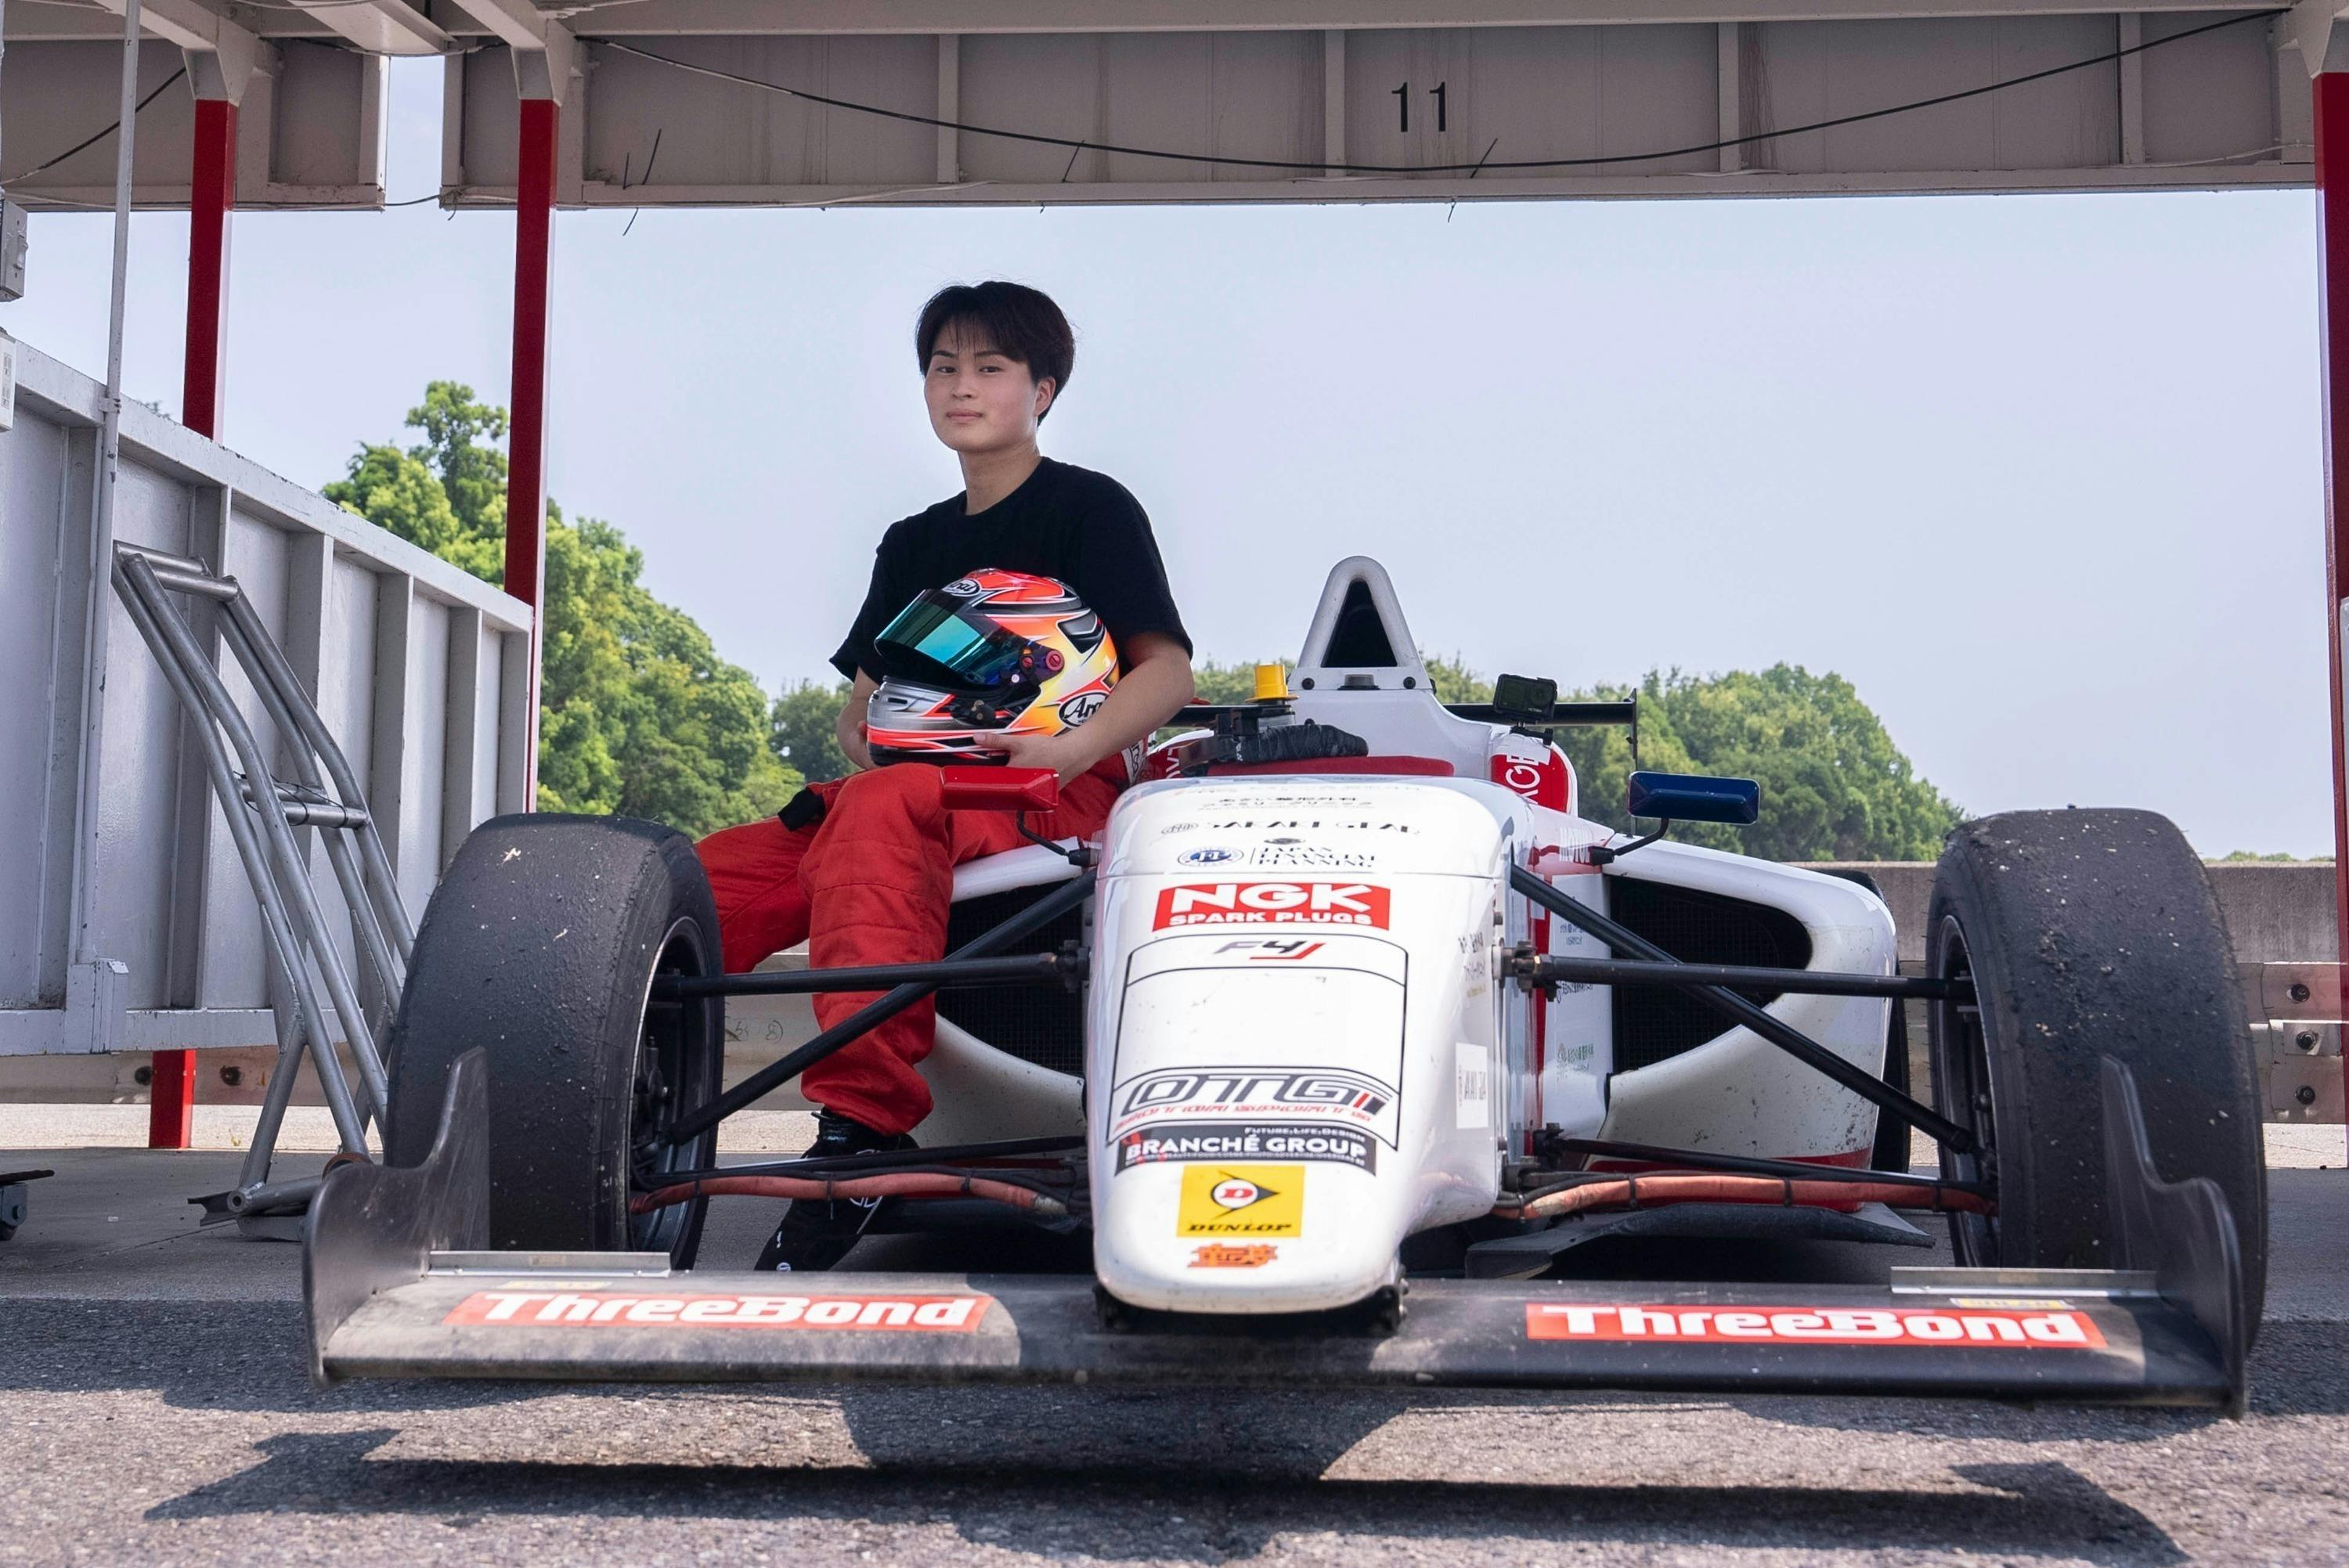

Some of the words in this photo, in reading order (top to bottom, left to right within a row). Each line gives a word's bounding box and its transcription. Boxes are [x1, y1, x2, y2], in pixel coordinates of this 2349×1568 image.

[1391, 81, 1446, 132] 11
[1171, 884, 1373, 914] NGK
[1169, 911, 1266, 926] SPARK
[1275, 910, 1373, 925] PLUGS
[1125, 1134, 1260, 1162] BRANCHÉ
[1265, 1137, 1367, 1159] GROUP
[1186, 1223, 1292, 1233] DUNLOP
[484, 1292, 977, 1328] ThreeBond
[1543, 1305, 2089, 1343] ThreeBond
